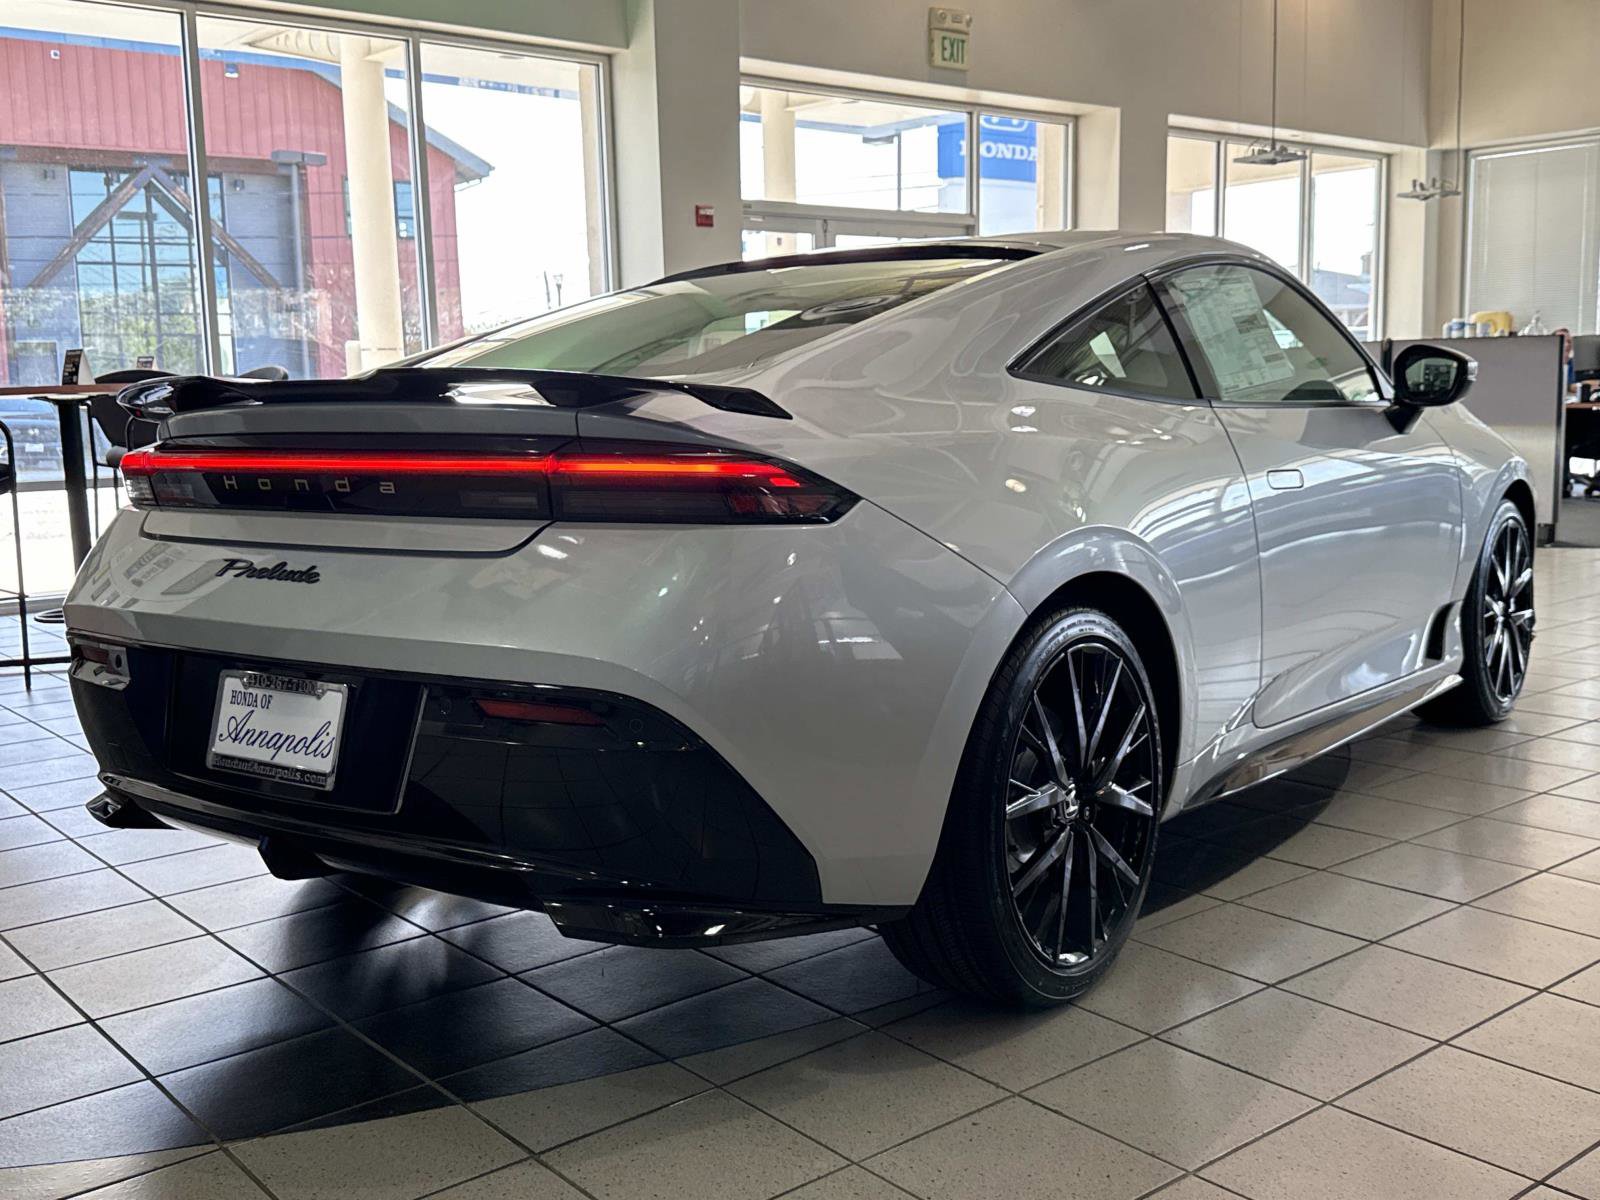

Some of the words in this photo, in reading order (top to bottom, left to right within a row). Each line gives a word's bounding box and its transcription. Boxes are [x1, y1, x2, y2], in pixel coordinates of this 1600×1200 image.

[941, 36, 966, 64] EXIT
[223, 475, 396, 494] Honda
[215, 558, 320, 584] Prelude
[230, 689, 258, 709] HONDA
[260, 693, 273, 709] OF
[218, 709, 336, 760] Annapolis
